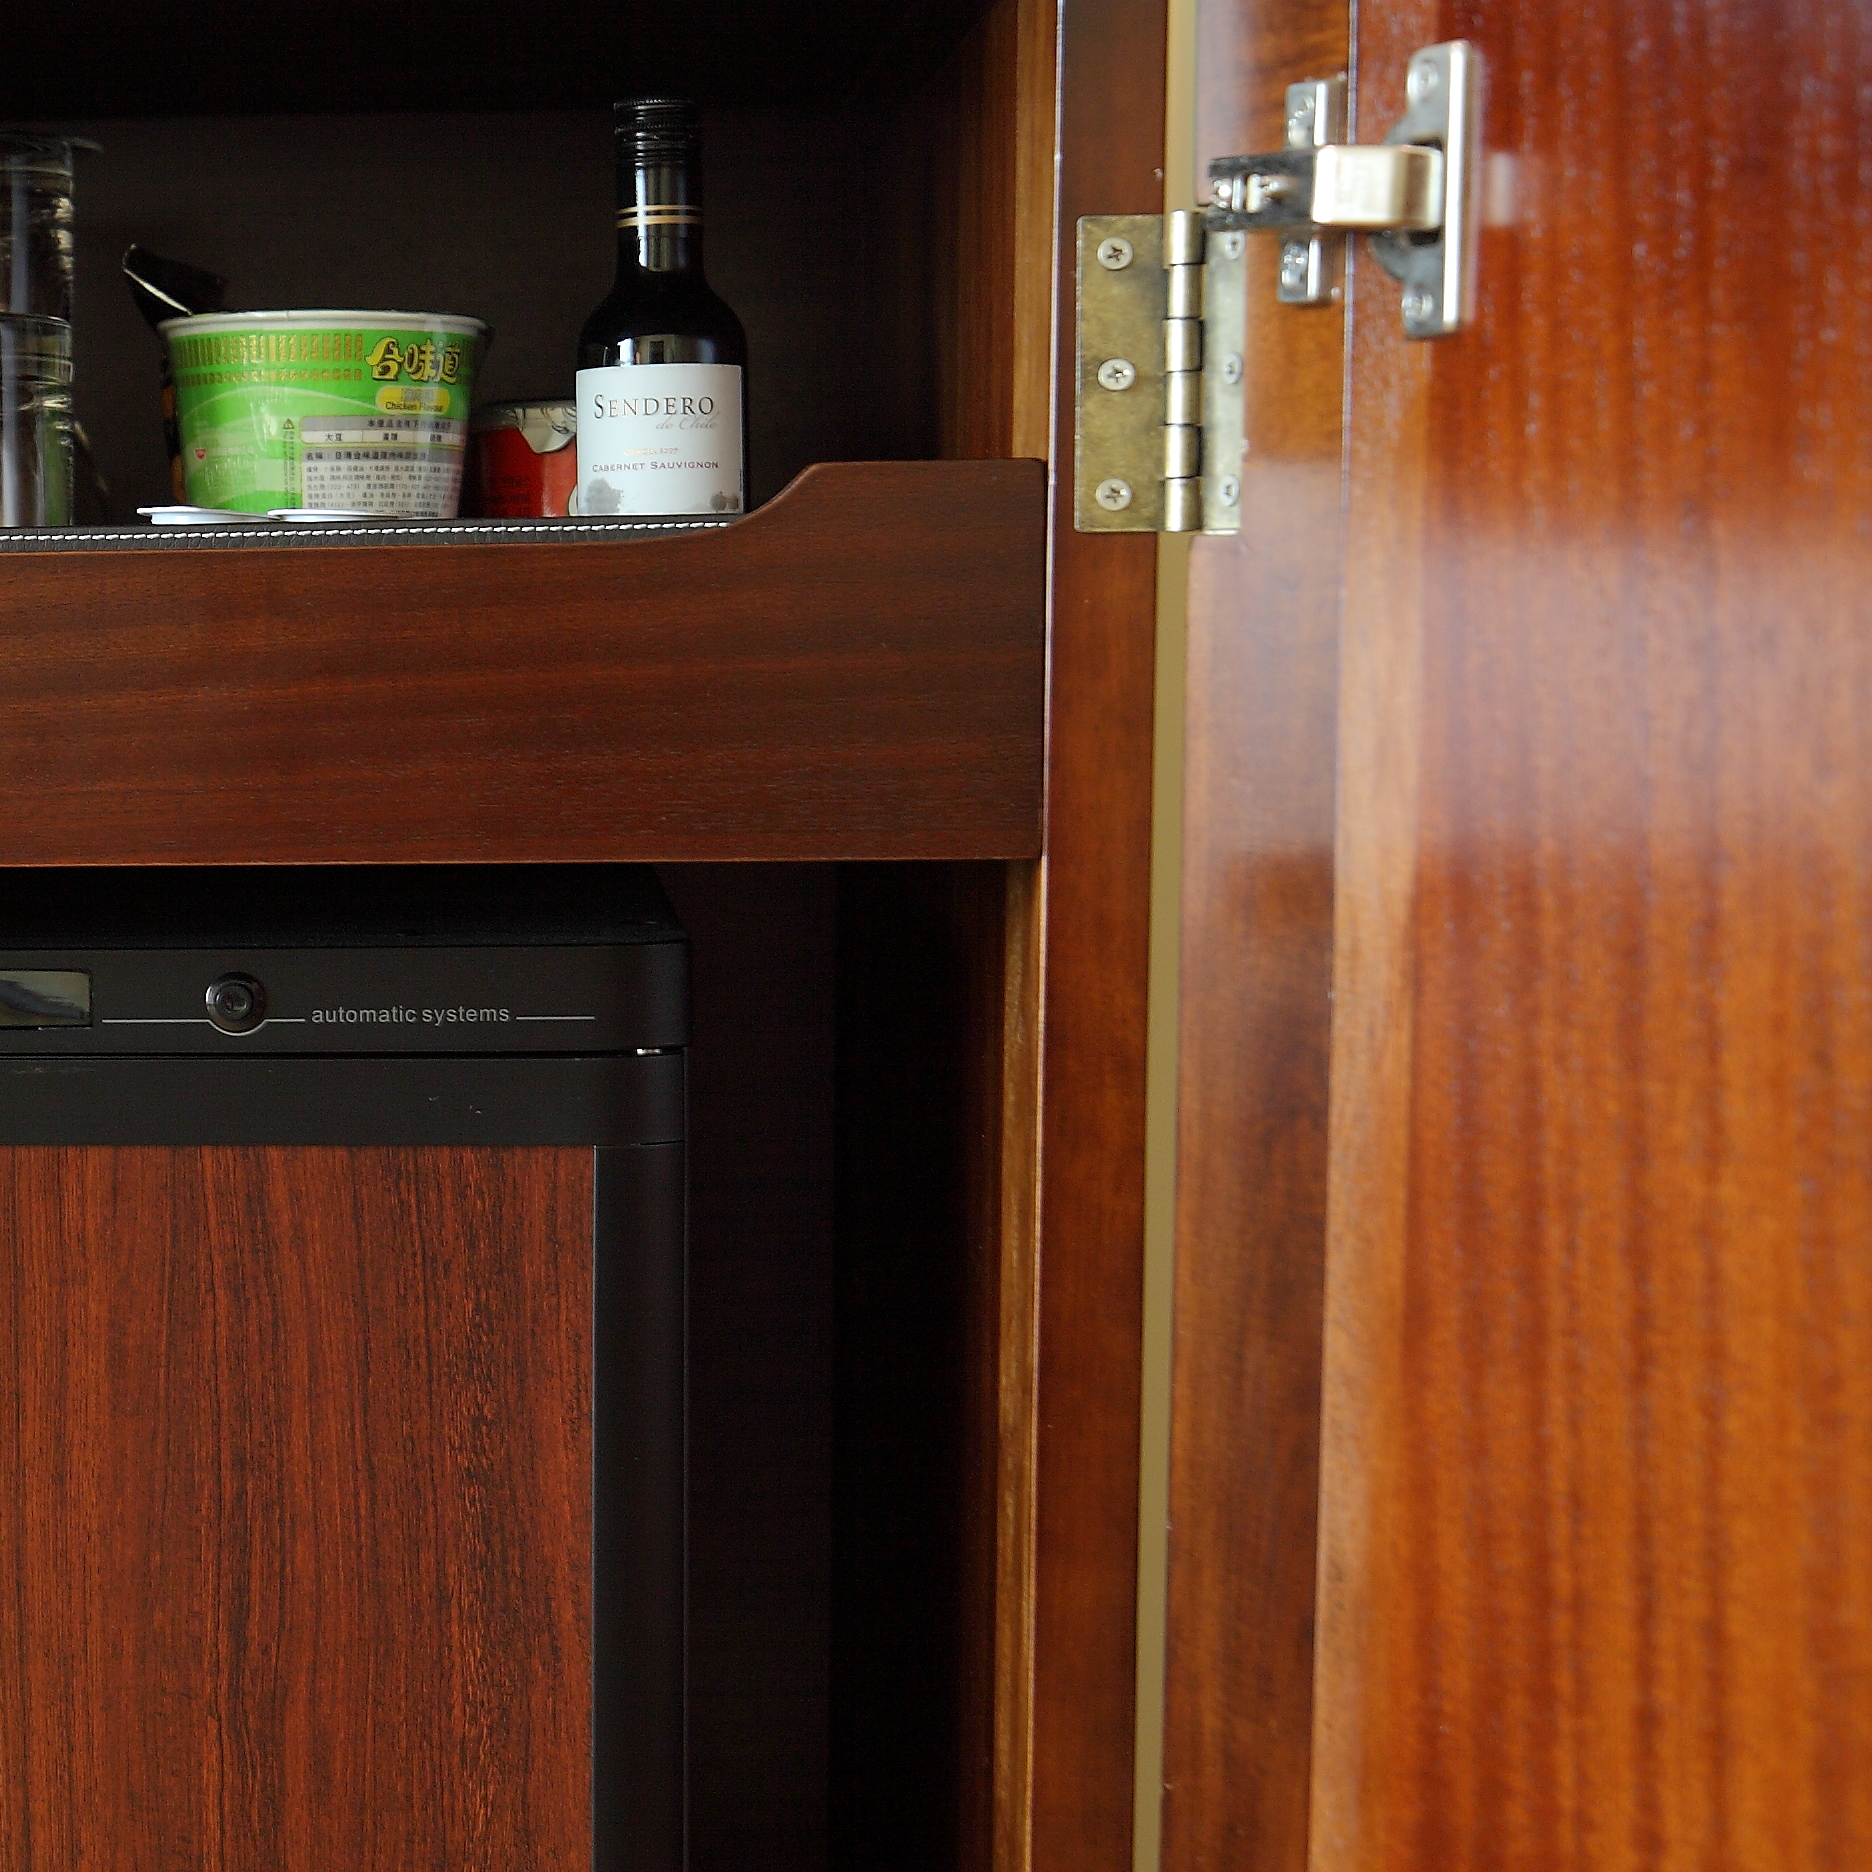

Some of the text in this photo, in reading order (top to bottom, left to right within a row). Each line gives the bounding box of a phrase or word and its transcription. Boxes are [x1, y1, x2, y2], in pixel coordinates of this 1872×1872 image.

[364, 336, 462, 385] 合味道
[593, 393, 715, 420] SENDERO
[592, 461, 719, 473] CABERNET SAUVIGNON
[311, 1003, 510, 1027] automatic systems
